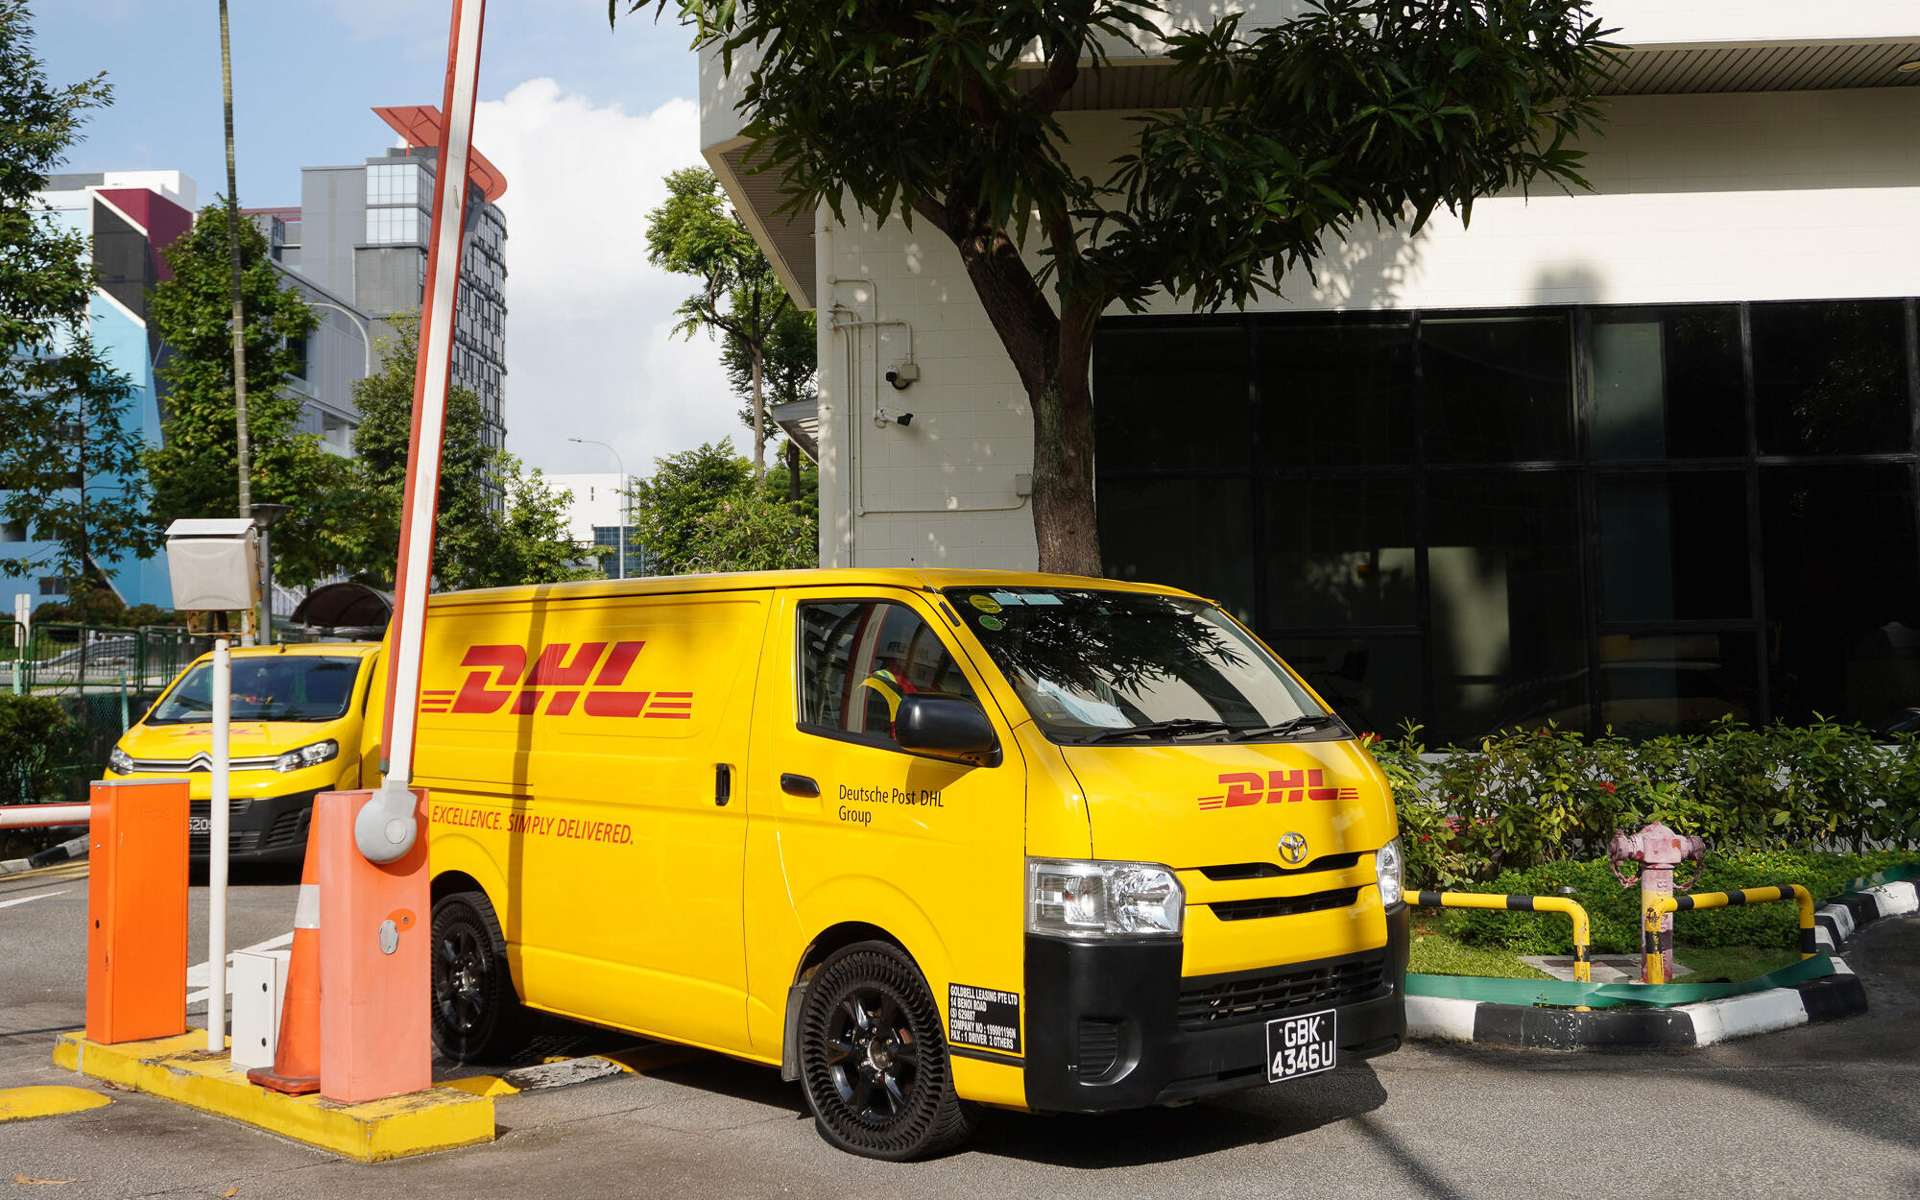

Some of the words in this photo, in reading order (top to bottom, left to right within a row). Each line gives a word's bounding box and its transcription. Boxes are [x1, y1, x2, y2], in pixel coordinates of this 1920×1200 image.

[450, 641, 651, 718] DHL
[840, 785, 888, 803] Deutsche
[892, 788, 916, 805] Post
[920, 790, 944, 807] DHL
[1218, 769, 1339, 808] DHL
[432, 805, 502, 830] EXCELLENCE.
[507, 813, 555, 835] SIMPLY
[557, 818, 634, 845] DELIVERED.
[839, 805, 872, 827] Group
[973, 1000, 987, 1012] ROAD
[976, 989, 997, 1002] LEASING
[998, 992, 1007, 1004] PTE
[1008, 994, 1018, 1006] LTD
[950, 1019, 974, 1031] COMPANY
[976, 1022, 983, 1033] NO
[1285, 1016, 1320, 1048] GBK
[950, 1029, 960, 1041] PAX
[968, 1033, 987, 1045] DRIVER
[993, 1037, 1014, 1049] OTHERS
[1272, 1040, 1333, 1077] 4346U
